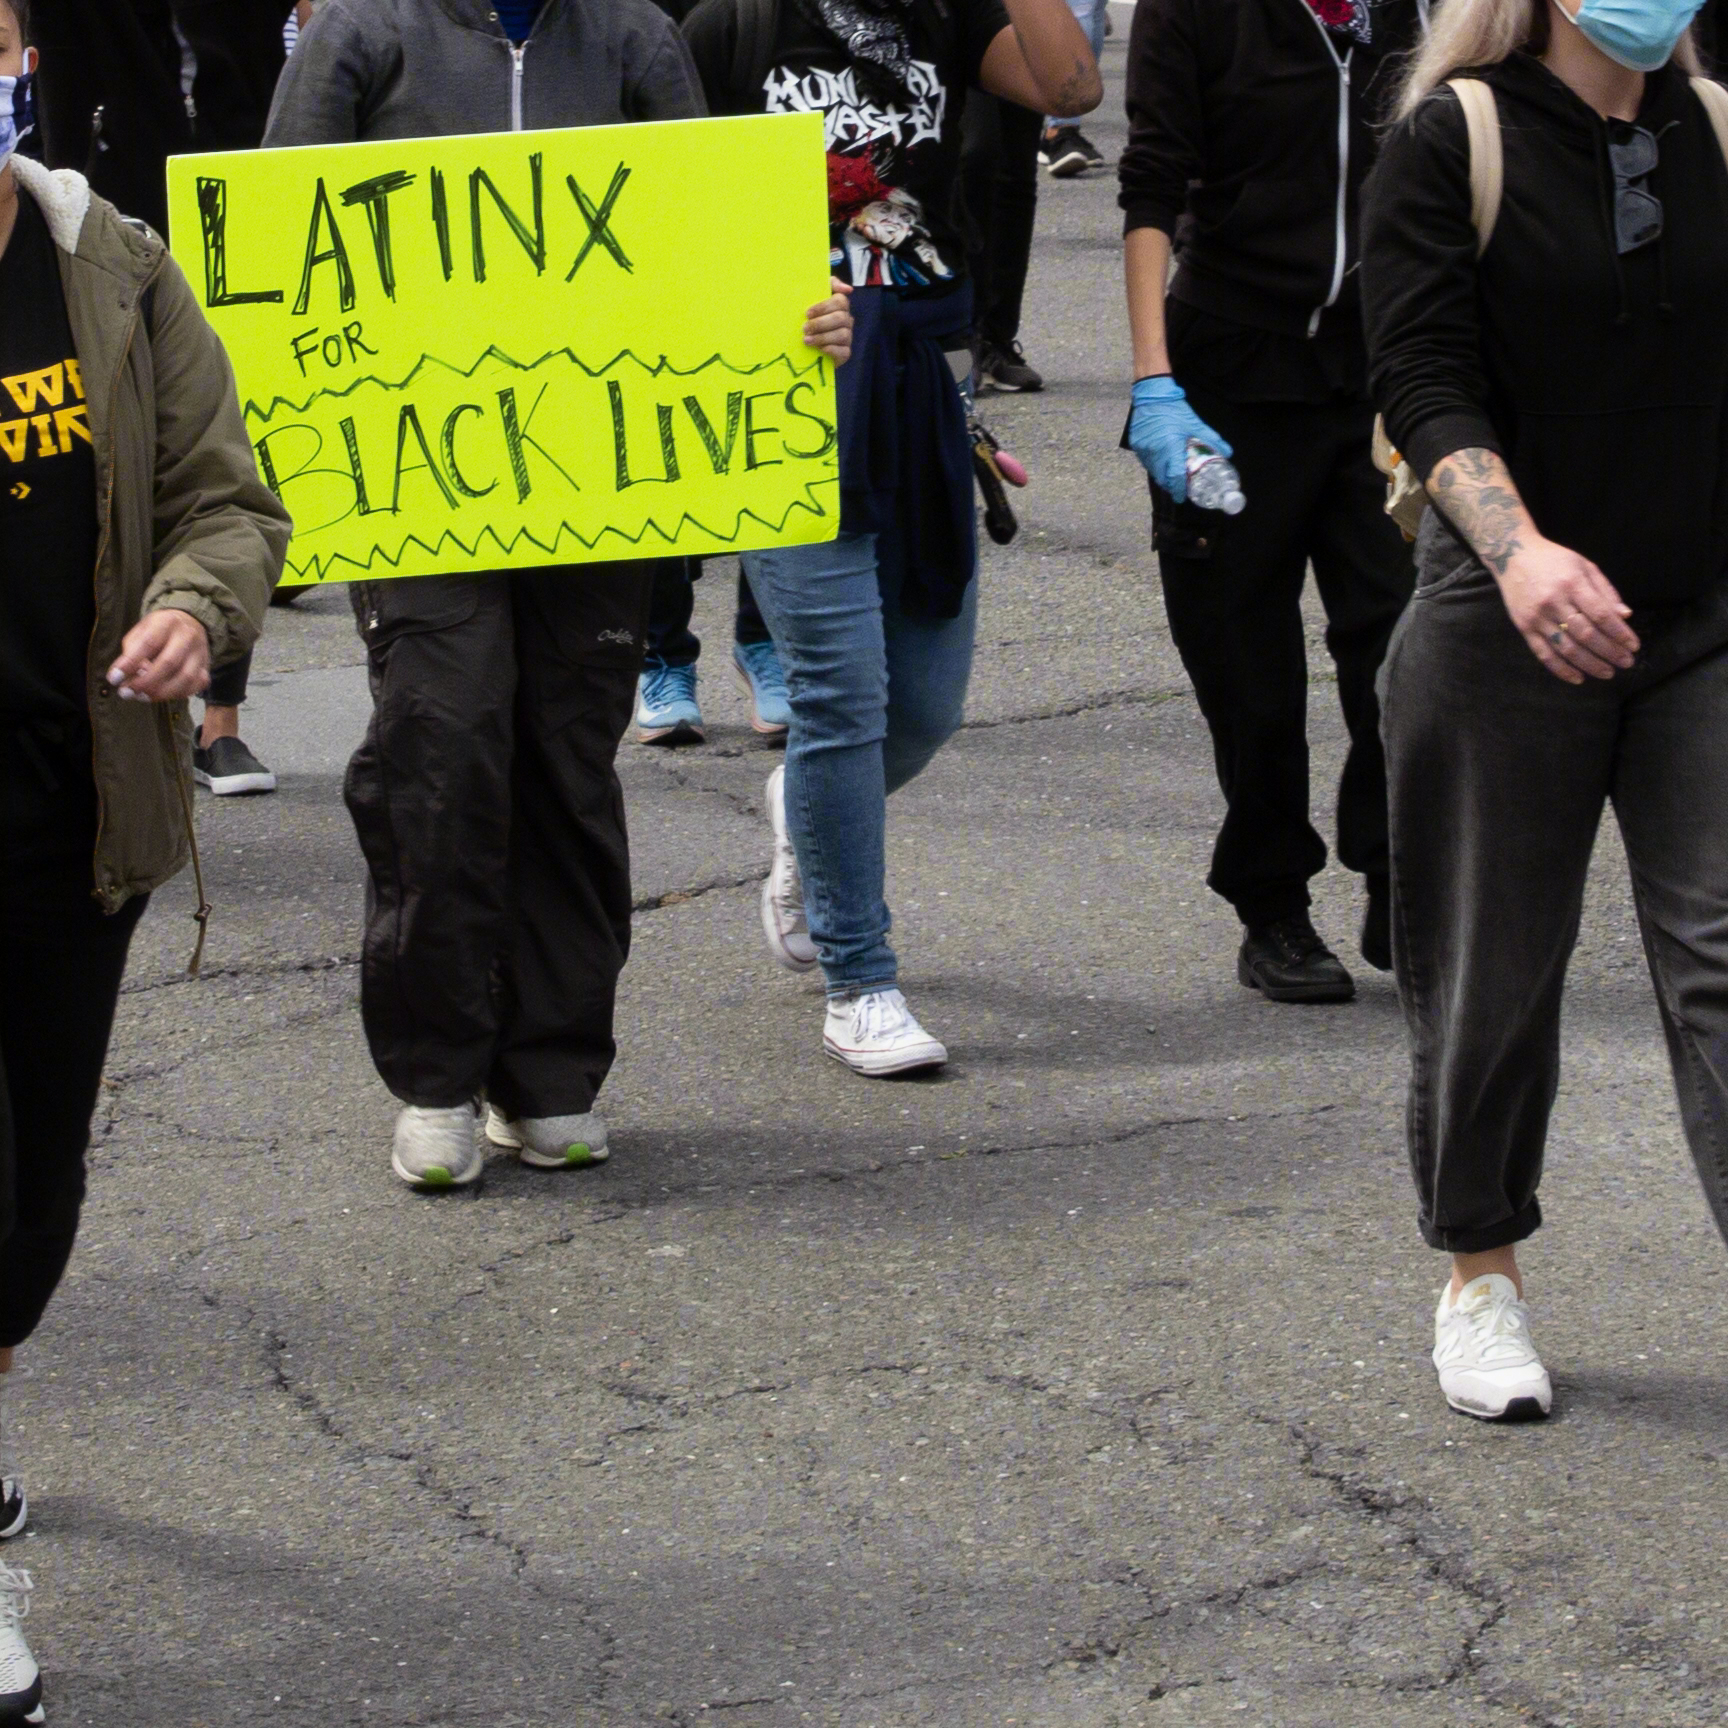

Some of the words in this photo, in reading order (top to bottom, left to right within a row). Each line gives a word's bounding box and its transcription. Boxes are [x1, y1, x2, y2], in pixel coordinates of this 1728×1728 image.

[195, 151, 636, 317] LATINX
[290, 319, 380, 378] FOR
[253, 380, 582, 543] BLACK
[606, 379, 839, 494] LIVES
